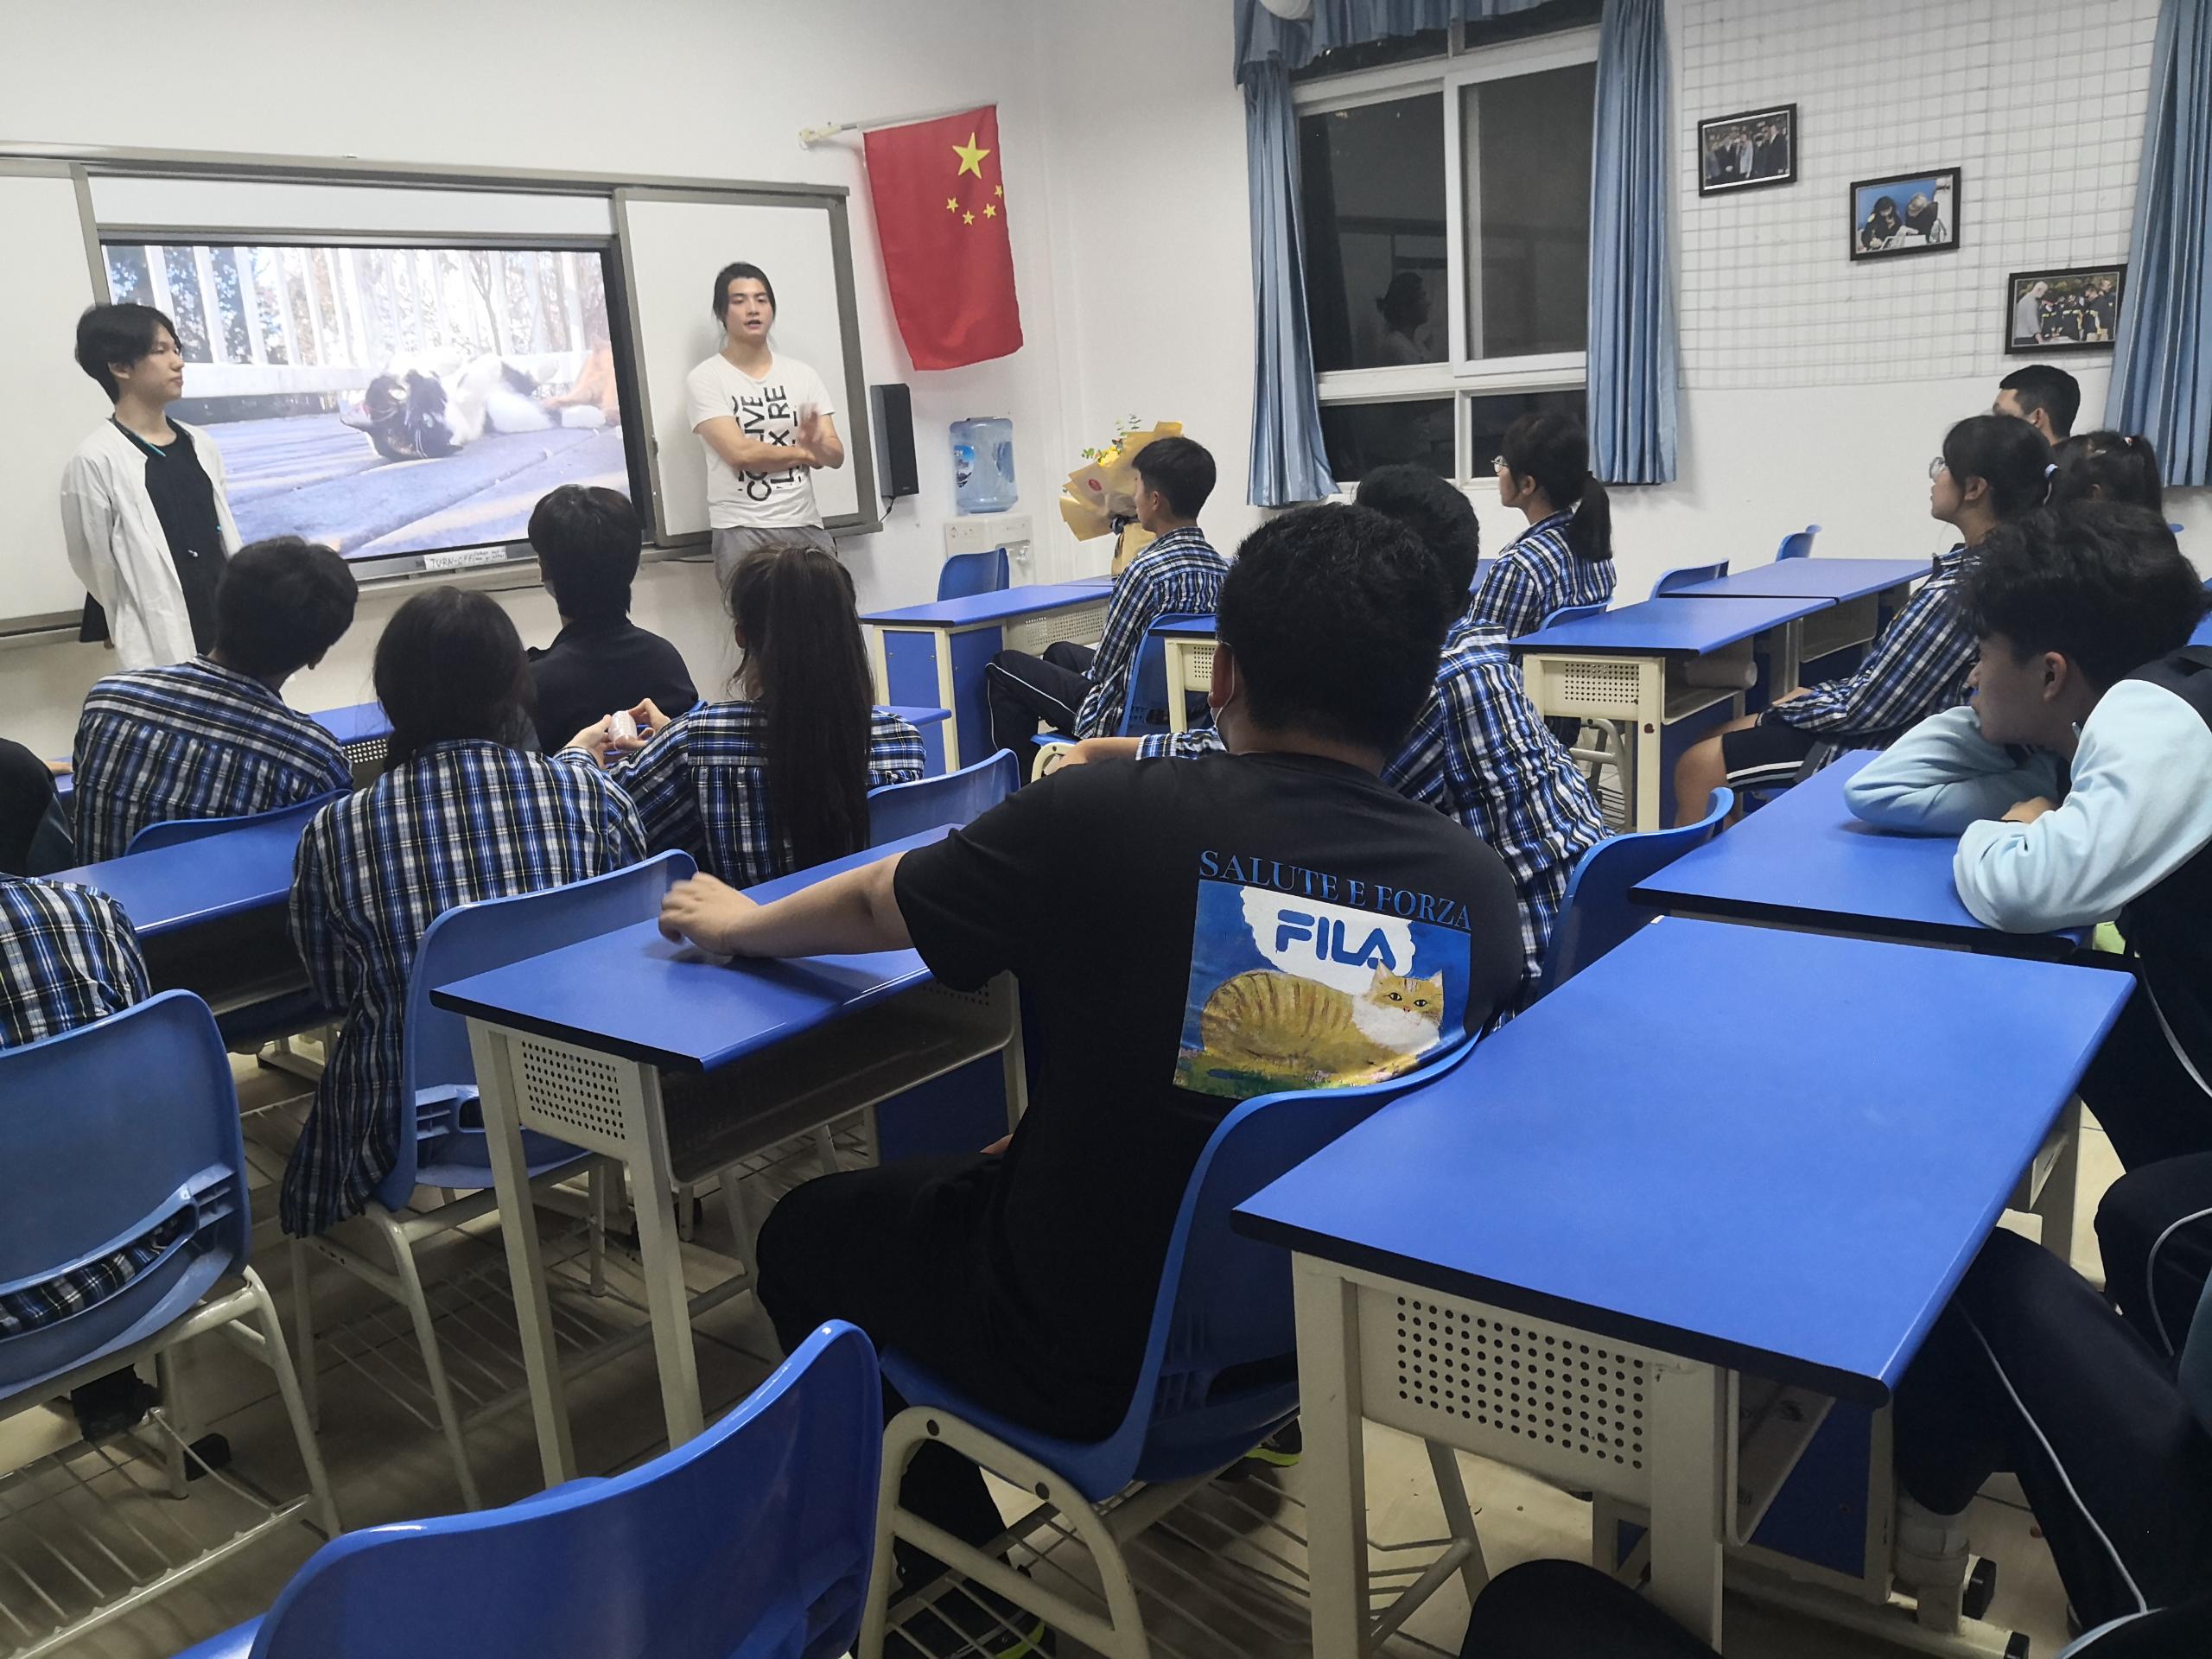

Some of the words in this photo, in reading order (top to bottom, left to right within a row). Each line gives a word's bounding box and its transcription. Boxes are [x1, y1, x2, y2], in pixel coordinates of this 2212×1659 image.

[1199, 850, 1338, 901] SALUTE
[1348, 879, 1366, 906] E
[1374, 885, 1471, 931] FORZA
[1276, 909, 1396, 970] FILA
